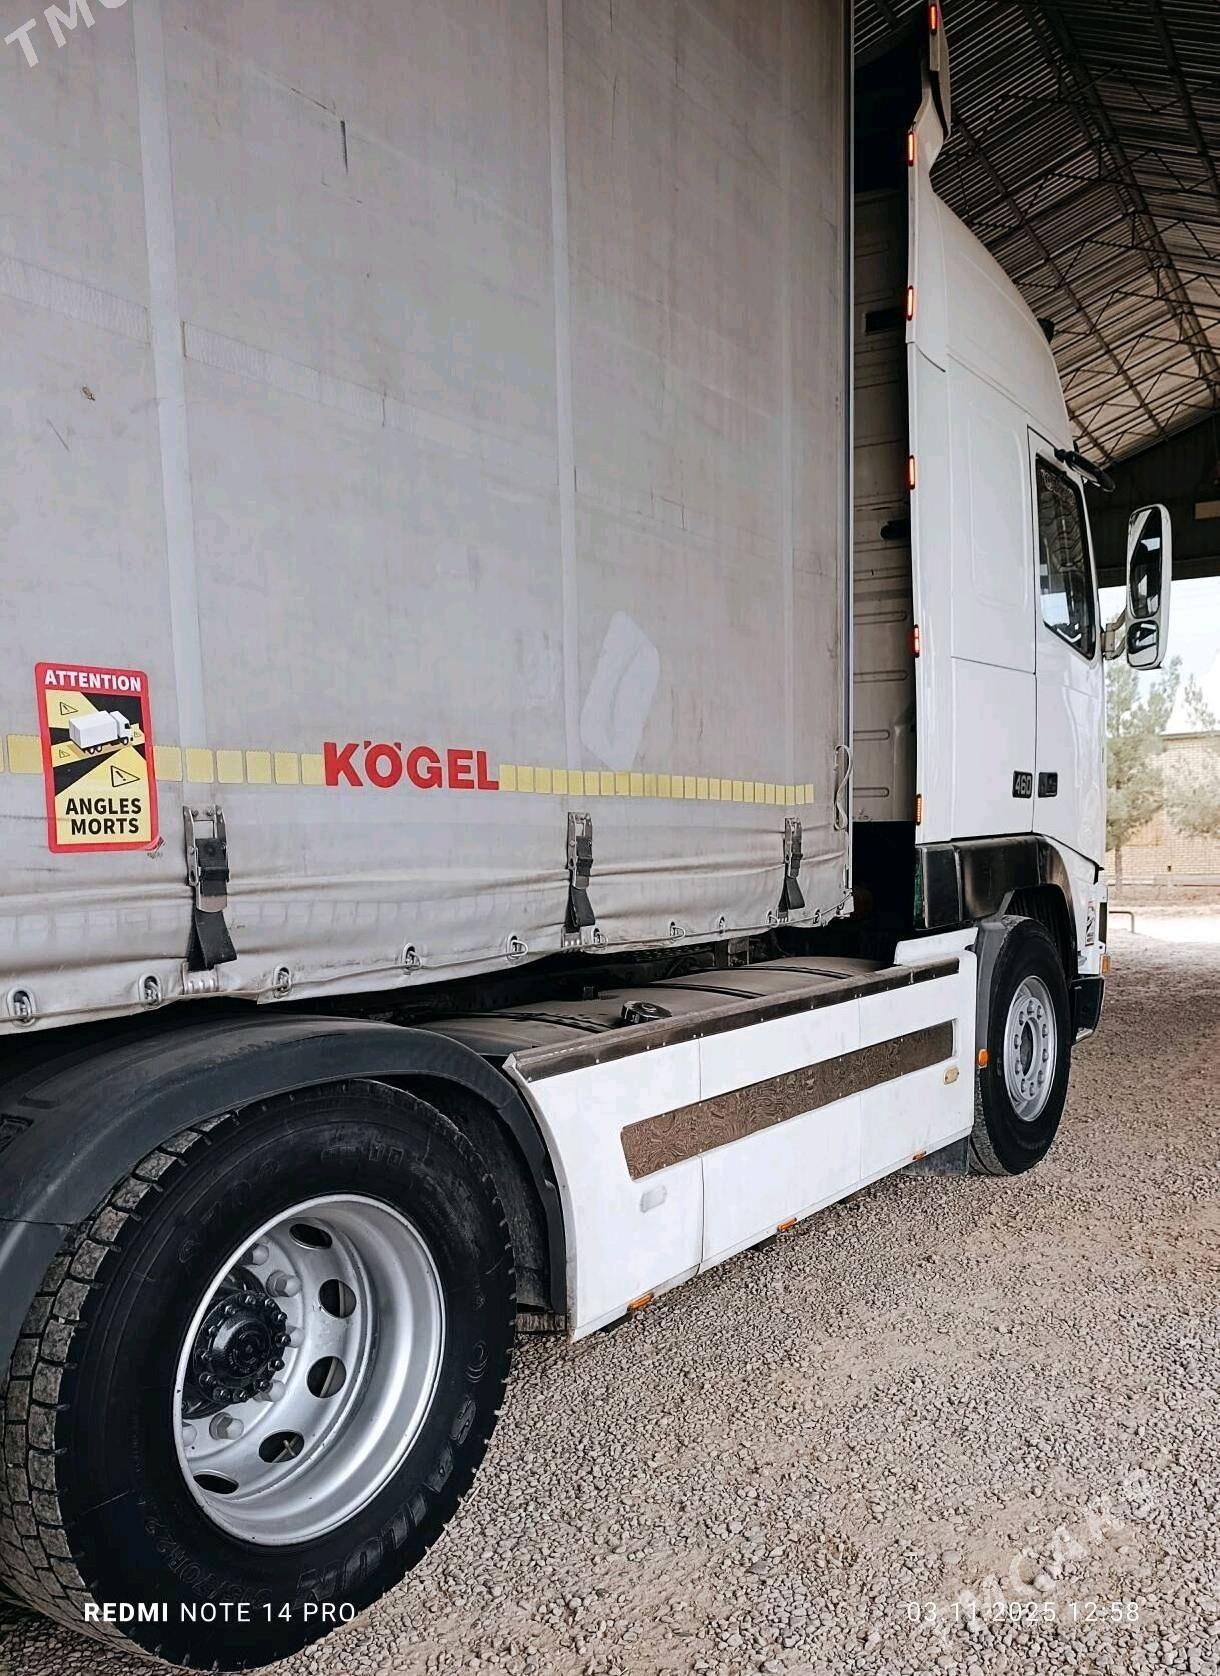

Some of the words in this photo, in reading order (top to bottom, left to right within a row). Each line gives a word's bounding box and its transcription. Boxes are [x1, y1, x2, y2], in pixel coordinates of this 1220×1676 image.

[44, 669, 142, 692] ATTENTION
[323, 740, 499, 790] KÖGEL
[1015, 774, 1032, 795] 460
[65, 797, 142, 816] ANGLES
[71, 817, 140, 836] MORTS
